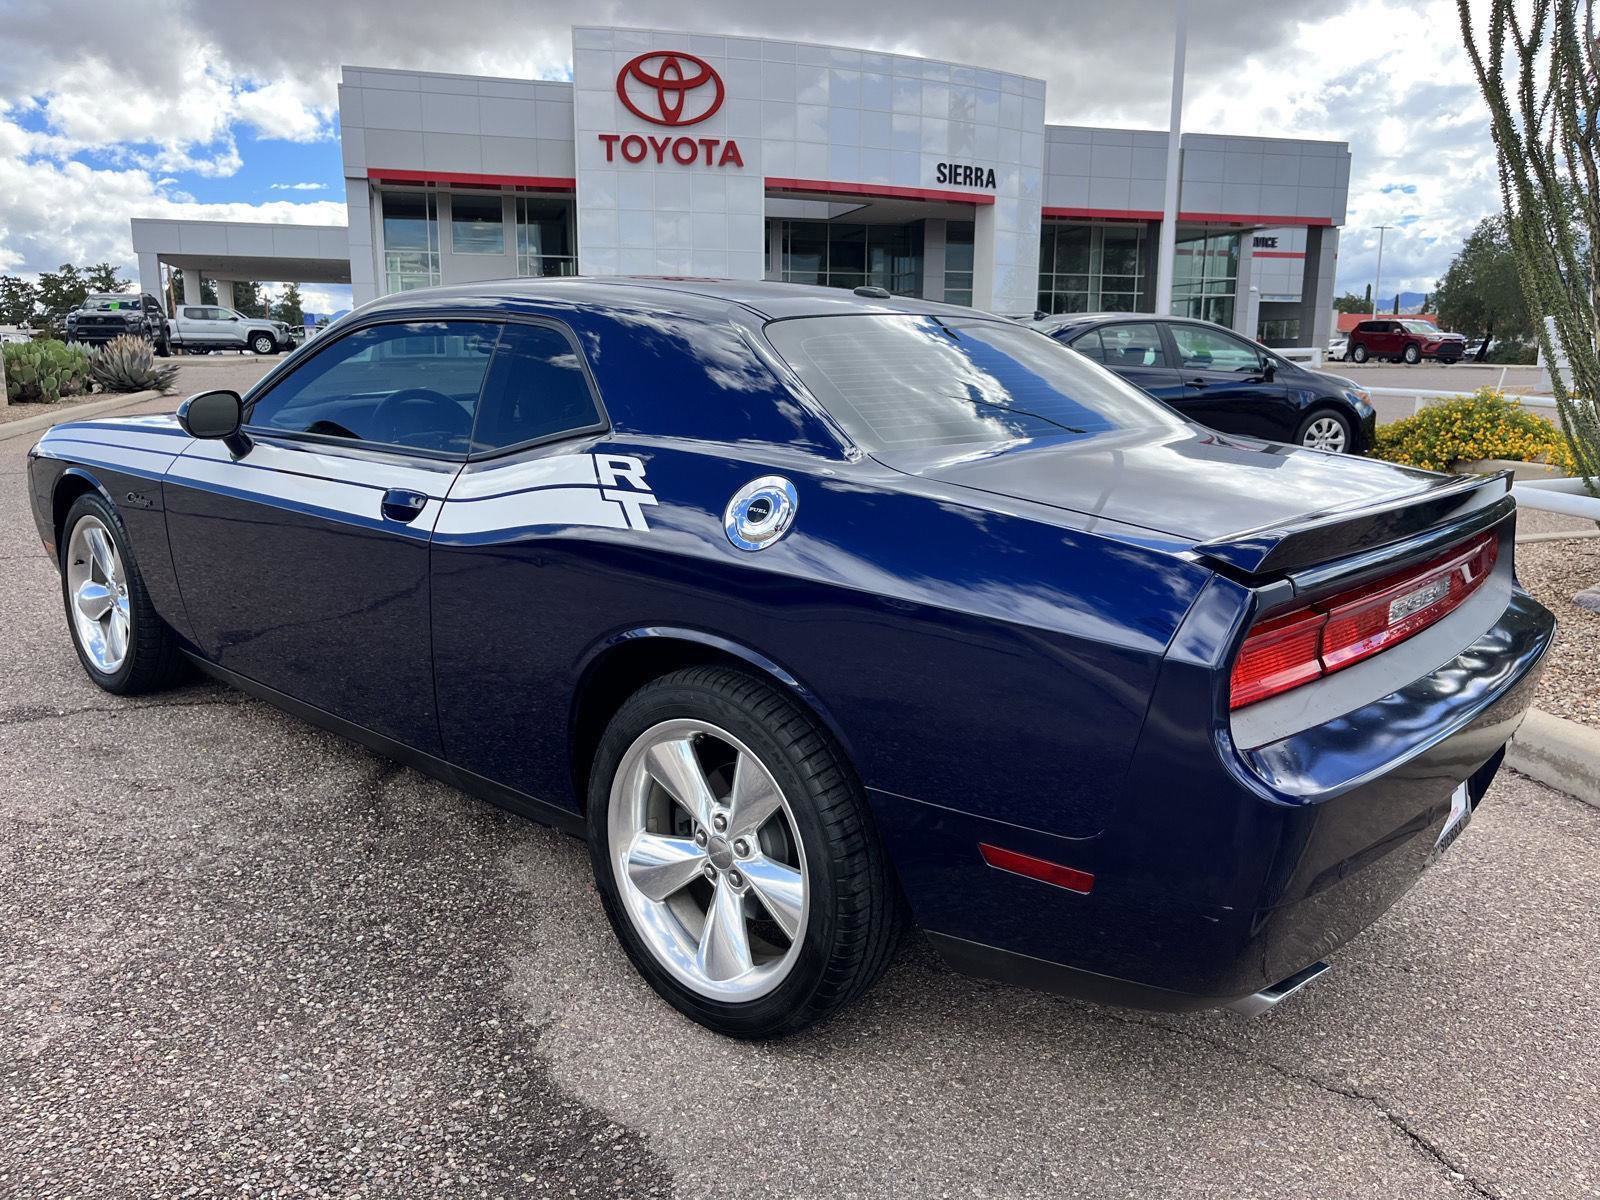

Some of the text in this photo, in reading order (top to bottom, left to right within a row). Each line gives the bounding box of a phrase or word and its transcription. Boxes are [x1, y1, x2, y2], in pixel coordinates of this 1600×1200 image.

[598, 134, 744, 167] TOYOTA
[936, 162, 997, 189] SIERRA
[595, 453, 652, 491] R
[748, 506, 768, 515] FUEL
